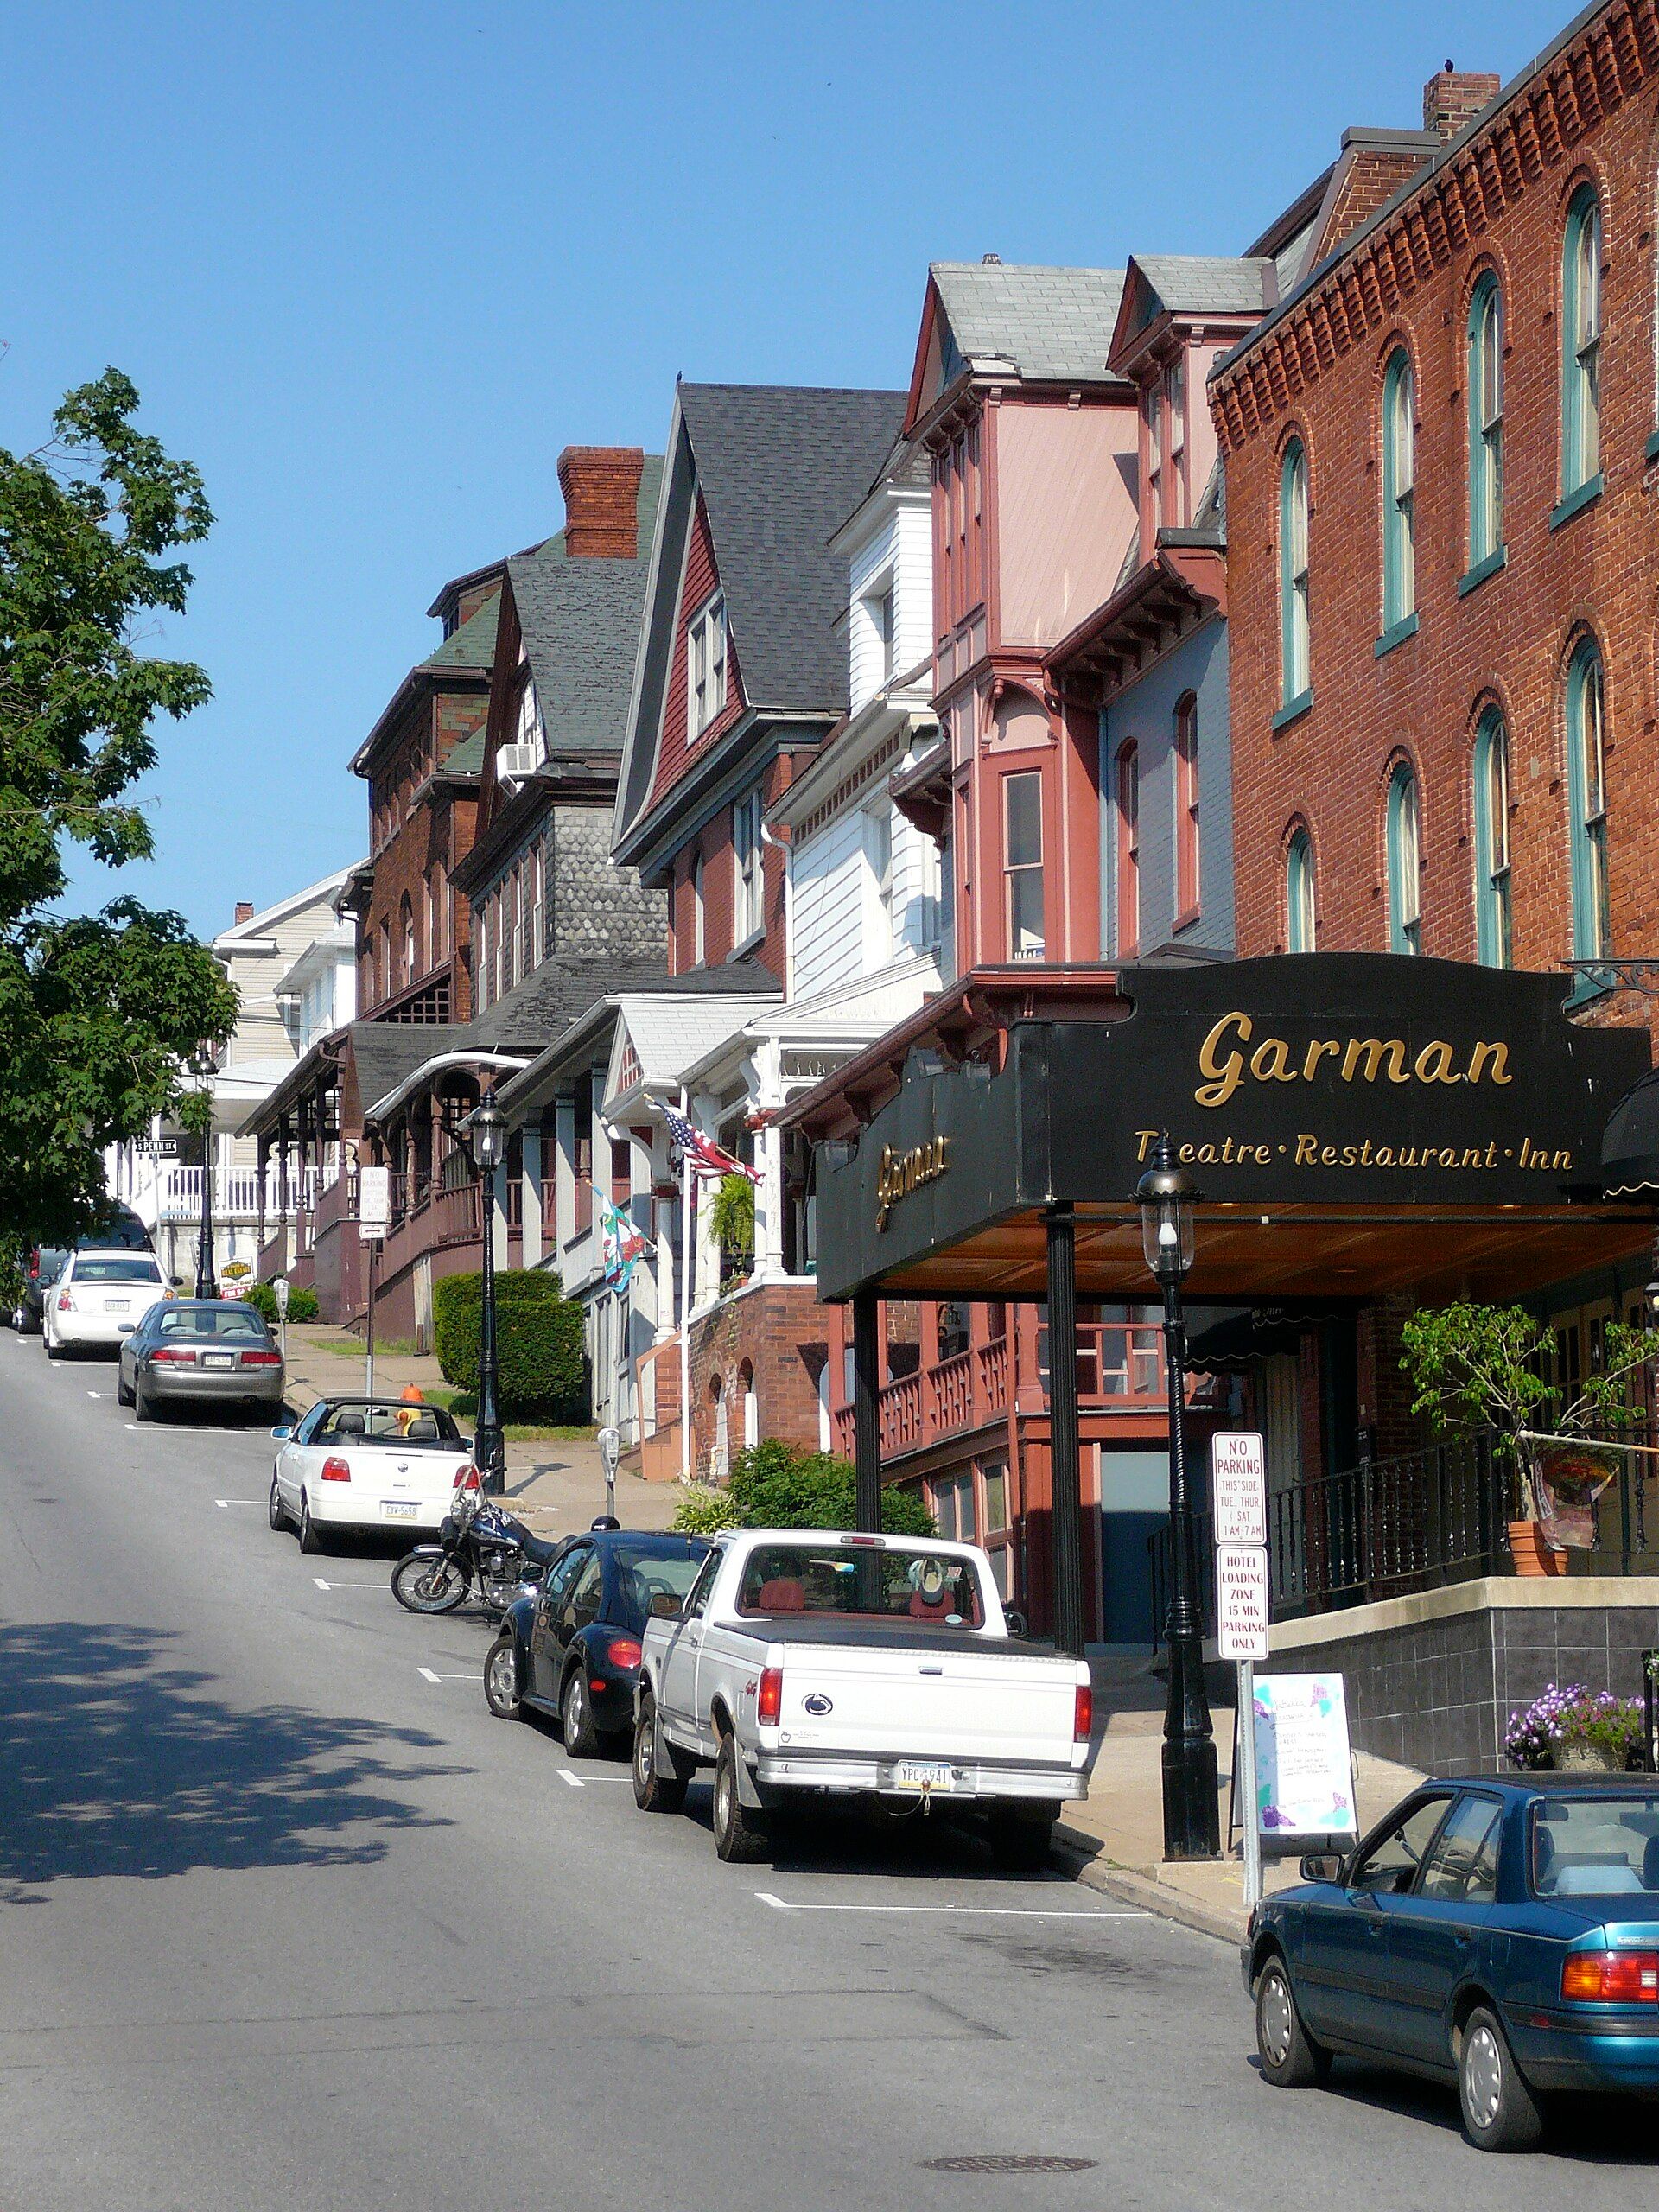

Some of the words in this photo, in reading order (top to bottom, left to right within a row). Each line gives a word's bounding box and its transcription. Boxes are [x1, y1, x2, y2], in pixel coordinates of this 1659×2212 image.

[1194, 1011, 1513, 1107] Garman
[143, 1141, 164, 1151] PENN
[1135, 1130, 1272, 1166] Teatre
[1295, 1134, 1498, 1170] Restaurant
[1520, 1137, 1573, 1171] Inn
[1229, 1440, 1248, 1455] NO
[1217, 1459, 1260, 1475] PARKING
[1222, 1480, 1238, 1491] THIS
[1241, 1480, 1257, 1491] SIDE
[1237, 1510, 1250, 1522] SAT
[1251, 1526, 1262, 1535] AM
[1227, 1556, 1258, 1567] HOTEL
[1222, 1573, 1264, 1584] LOADING
[1230, 1589, 1255, 1599] ZONE
[1228, 1605, 1238, 1616] 15
[1243, 1605, 1259, 1616] MIN
[1222, 1621, 1265, 1632] PARKING
[1232, 1638, 1255, 1649] ONLY
